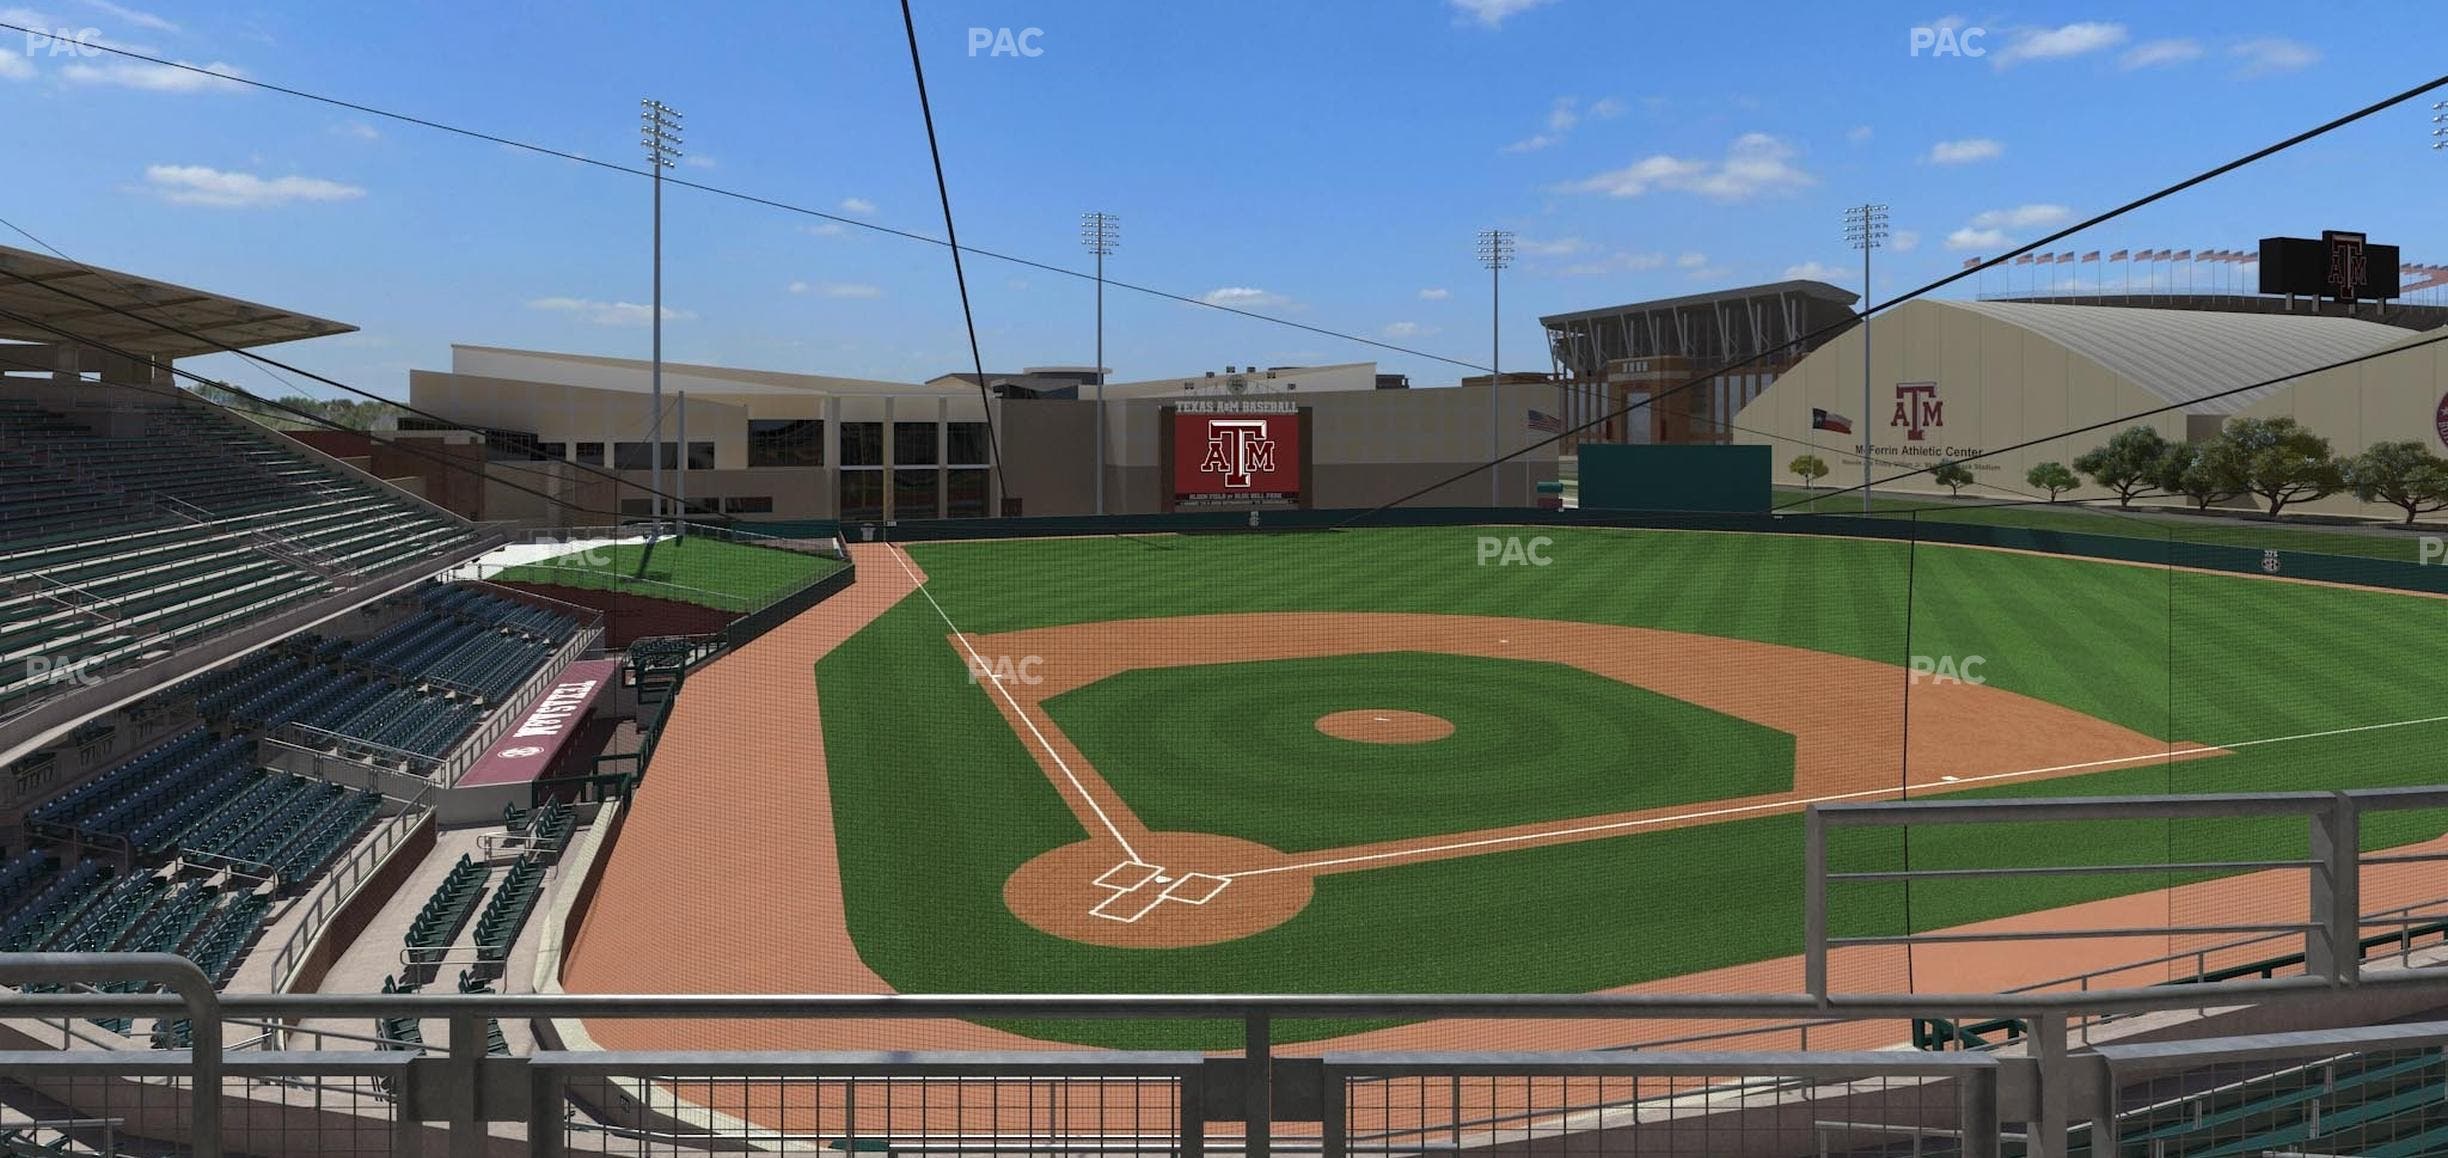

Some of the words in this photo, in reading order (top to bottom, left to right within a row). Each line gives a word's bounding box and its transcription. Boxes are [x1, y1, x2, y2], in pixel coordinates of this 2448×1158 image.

[1174, 401, 1214, 413] TEXAS
[1242, 401, 1299, 413] BASEBALL
[1855, 444, 1898, 456] MFerrin
[1901, 445, 1942, 457] Athletic
[1945, 446, 1983, 458] Center
